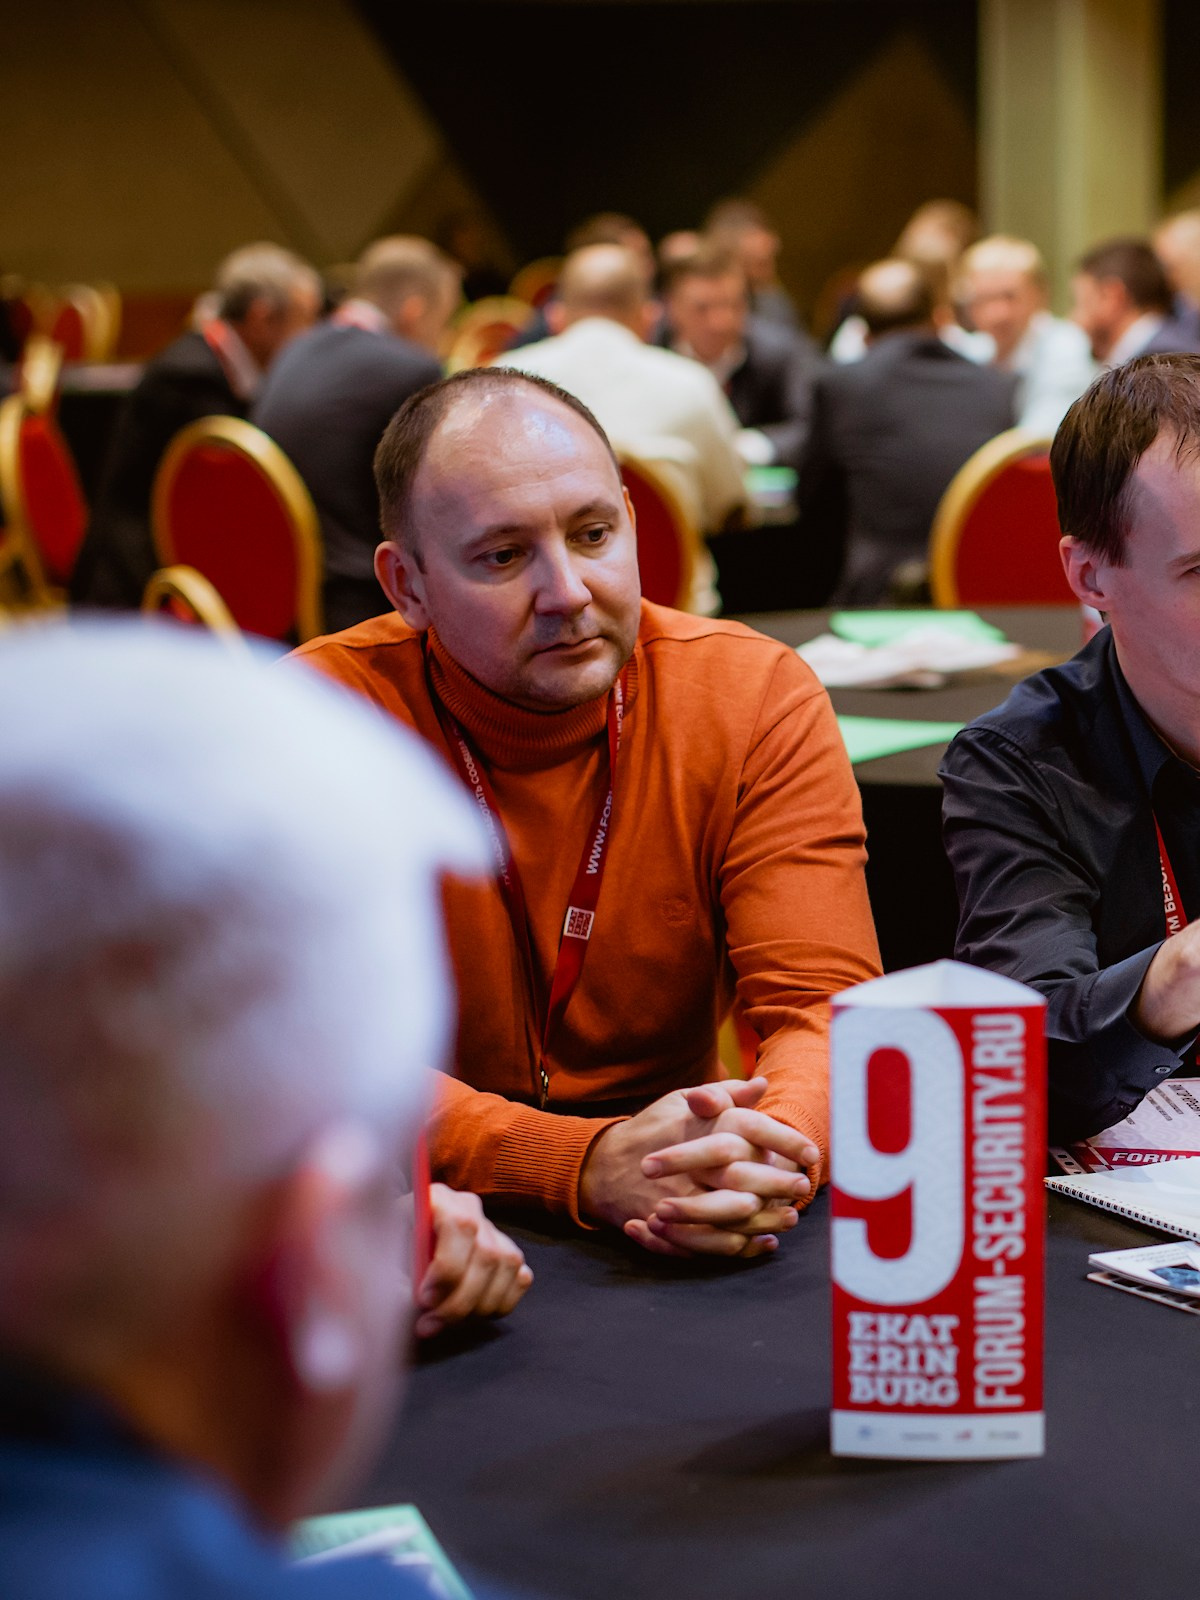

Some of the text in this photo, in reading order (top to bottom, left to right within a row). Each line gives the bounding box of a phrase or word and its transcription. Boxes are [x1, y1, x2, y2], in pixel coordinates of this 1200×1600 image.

[585, 790, 612, 873] WWW.FOR
[832, 1006, 965, 1306] 9
[973, 1013, 1027, 1408] FORUM-SECURITY.RU
[848, 1312, 959, 1344] EKAT
[848, 1344, 959, 1376] ERIN
[849, 1375, 959, 1407] BURG
